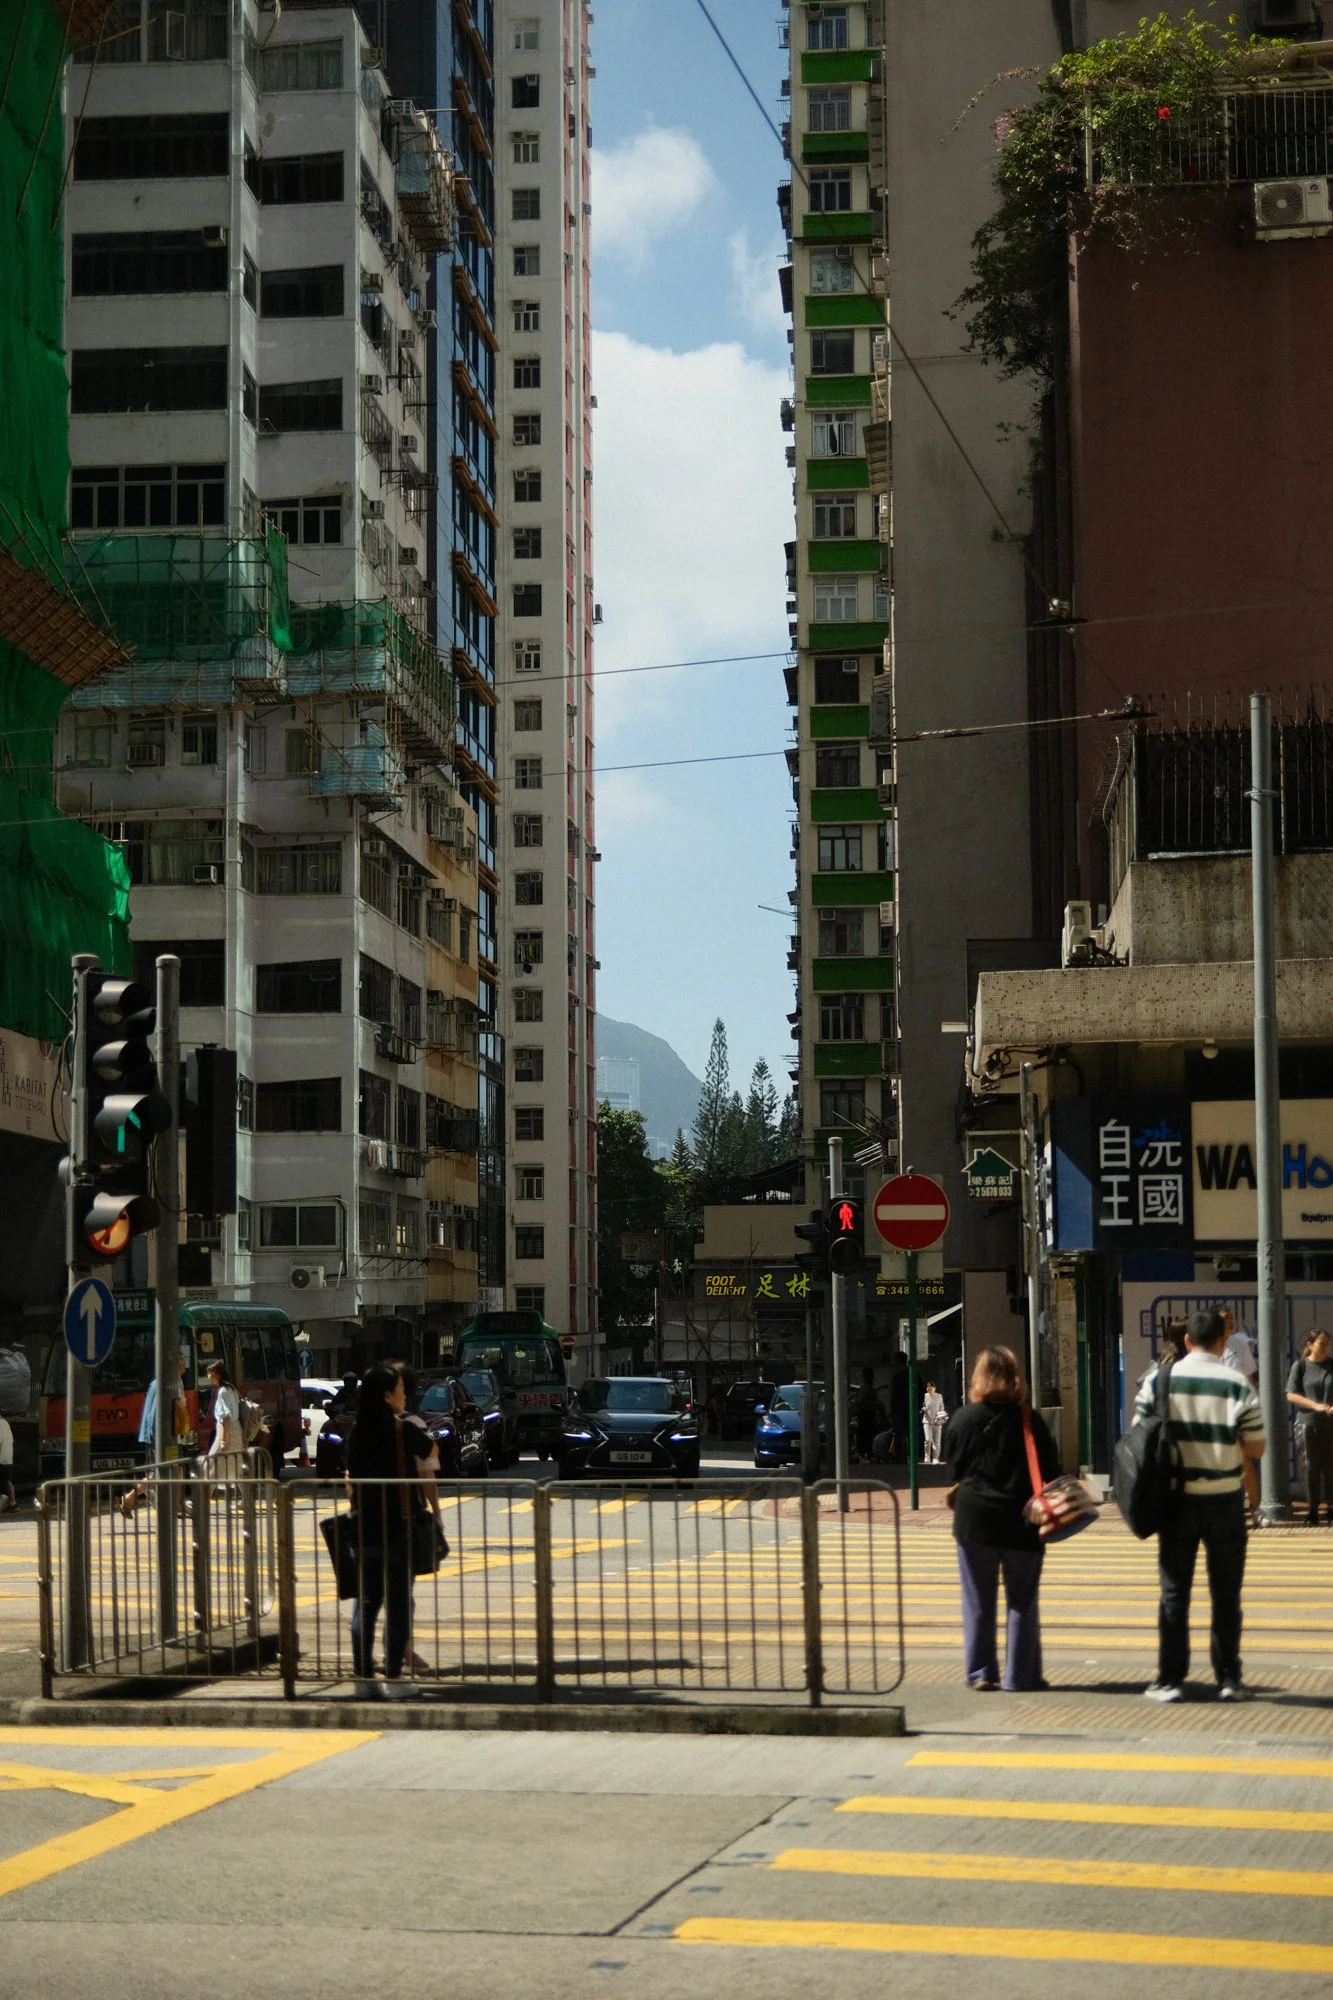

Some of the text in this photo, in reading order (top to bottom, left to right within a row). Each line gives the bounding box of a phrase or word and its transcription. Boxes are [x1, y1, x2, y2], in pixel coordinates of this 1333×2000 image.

[15, 1074, 48, 1099] KABITAT
[1098, 1174, 1183, 1226] 王國
[705, 1275, 737, 1286] FOOT
[705, 1286, 747, 1296] DELIGHT
[97, 1408, 129, 1420] FWD
